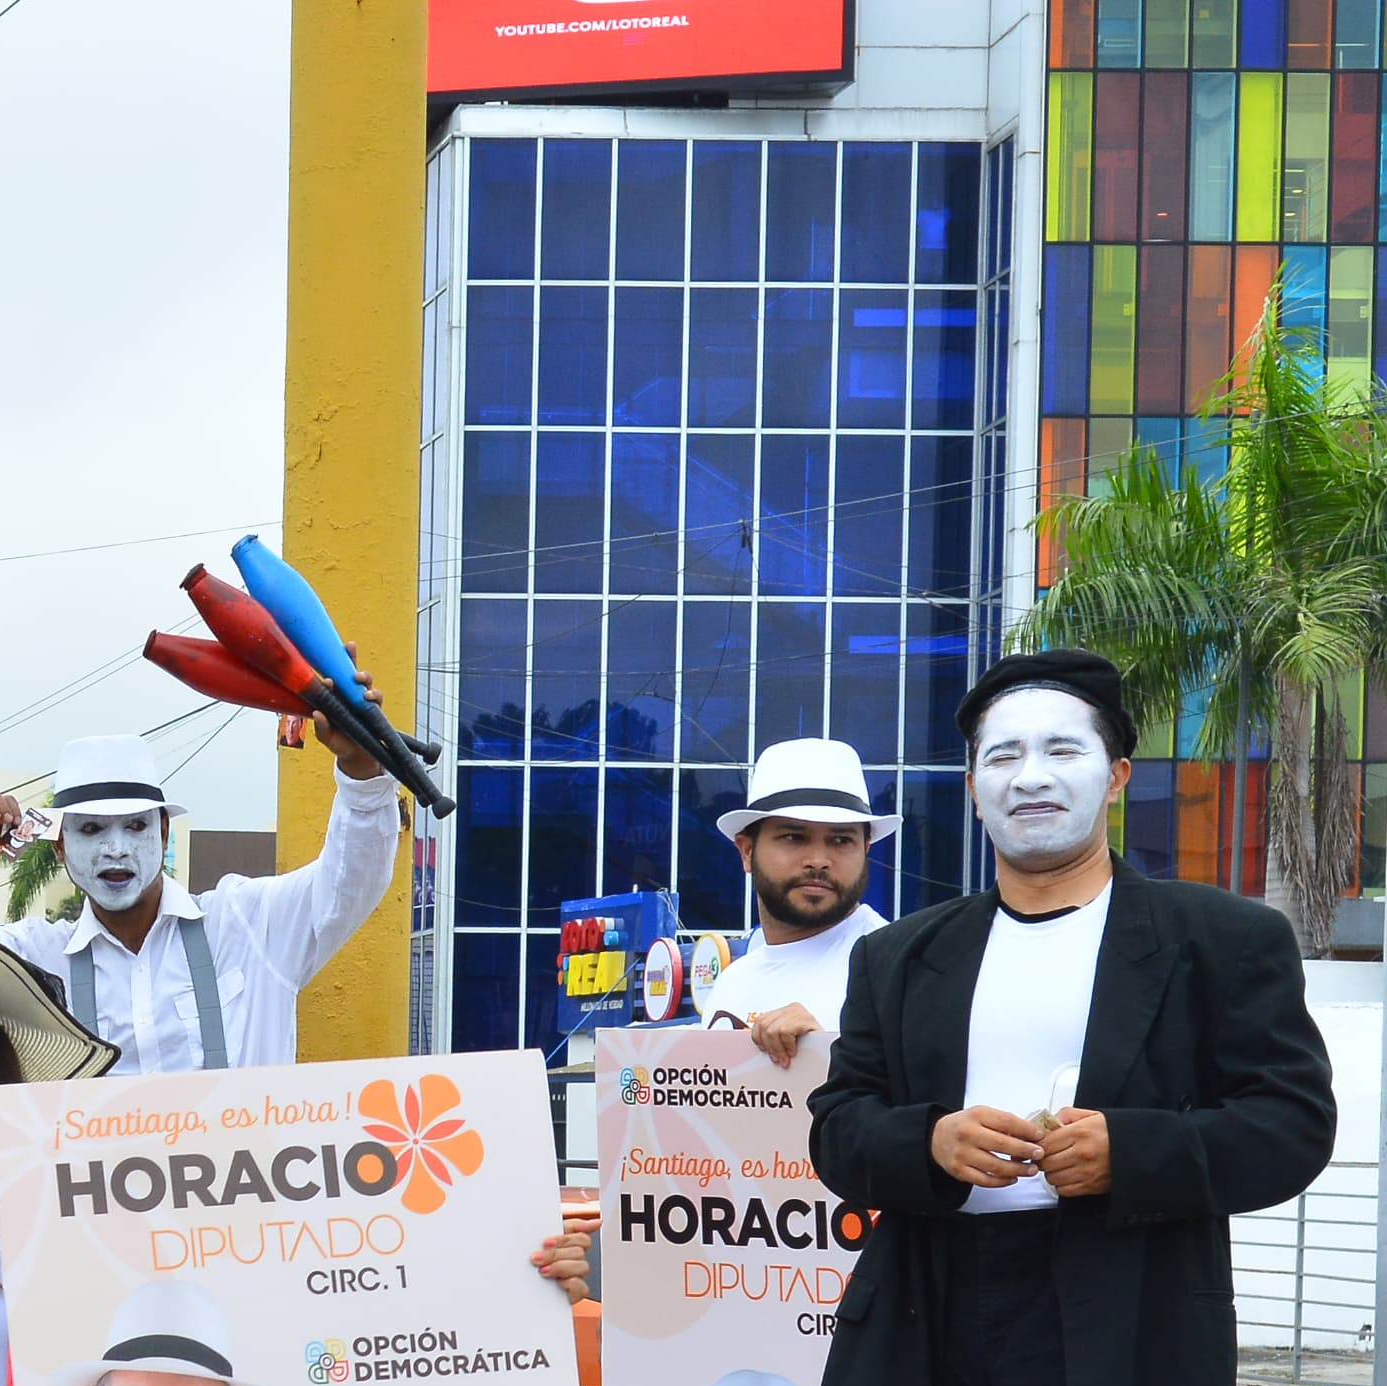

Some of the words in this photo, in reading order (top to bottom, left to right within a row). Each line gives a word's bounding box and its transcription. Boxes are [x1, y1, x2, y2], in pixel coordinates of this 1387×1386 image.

[495, 15, 689, 37] YOUTUBE.COM/LOTOREAL
[567, 951, 627, 996] REAL
[653, 1064, 727, 1086] OPCIÓN
[653, 1086, 793, 1109] DEMOCRÁTICA
[54, 1108, 208, 1150] ¡Santiago,
[221, 1106, 258, 1128] es
[55, 1141, 398, 1217] HORACIO
[620, 1148, 732, 1187] ¡Santiago,
[741, 1159, 770, 1178] es
[620, 1193, 876, 1252] HORACIO
[150, 1214, 405, 1271] DIPUTADO
[306, 1267, 389, 1295] CIRC.
[396, 1265, 407, 1289] 1
[684, 1260, 854, 1304] DIPUTAD
[797, 1312, 840, 1336] CIR
[353, 1328, 458, 1356] OPCIÓN
[355, 1349, 550, 1381] DEMOCRÁTICA
